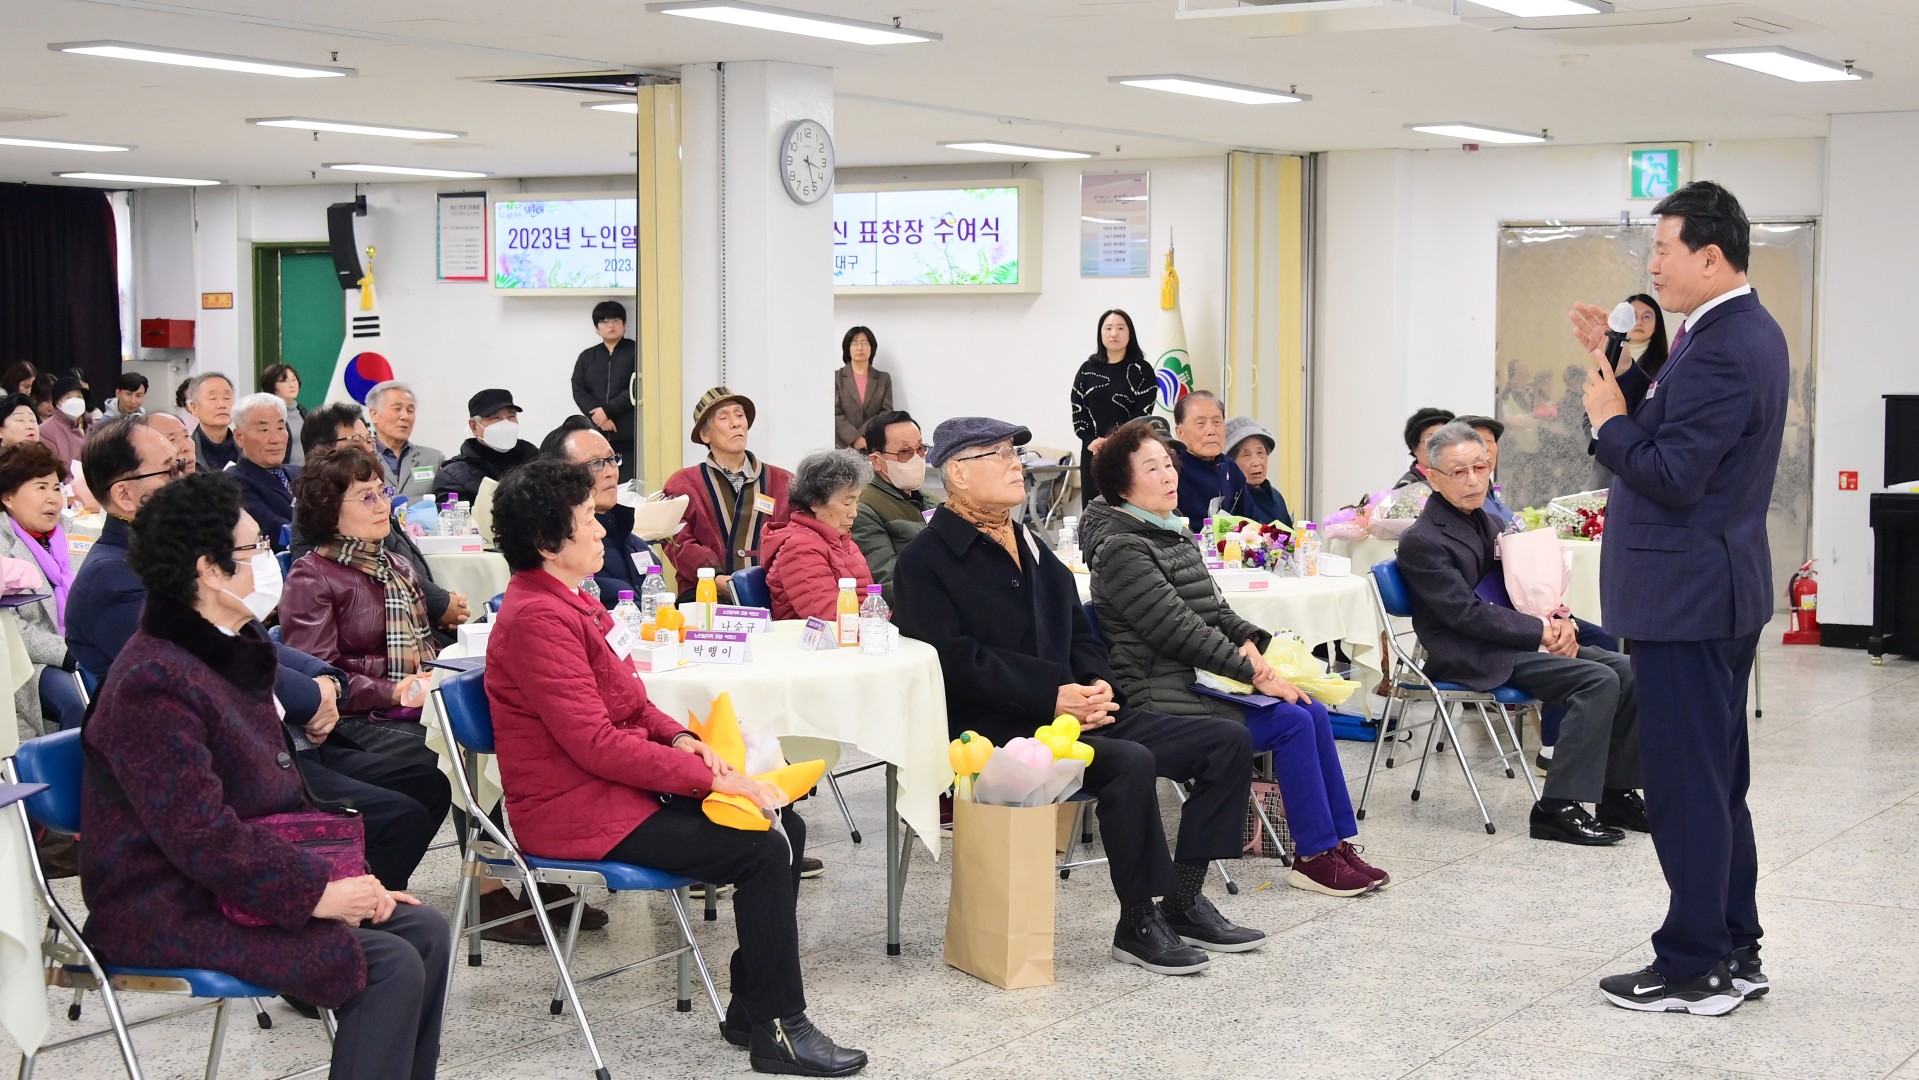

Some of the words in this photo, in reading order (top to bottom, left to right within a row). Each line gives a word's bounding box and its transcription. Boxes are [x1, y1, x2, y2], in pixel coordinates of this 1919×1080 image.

[804, 128, 811, 138] 12
[819, 143, 824, 153] 2
[787, 156, 793, 165] 9
[822, 158, 827, 168] 3
[790, 171, 796, 181] 8
[796, 180, 801, 191] 7
[803, 186, 809, 195] 6
[508, 226, 570, 250] 2023년
[858, 218, 925, 245] 표창장
[934, 217, 999, 244] 수여식
[604, 258, 634, 273] 2023.
[835, 255, 859, 271] 대구
[693, 644, 732, 658] 박행이
